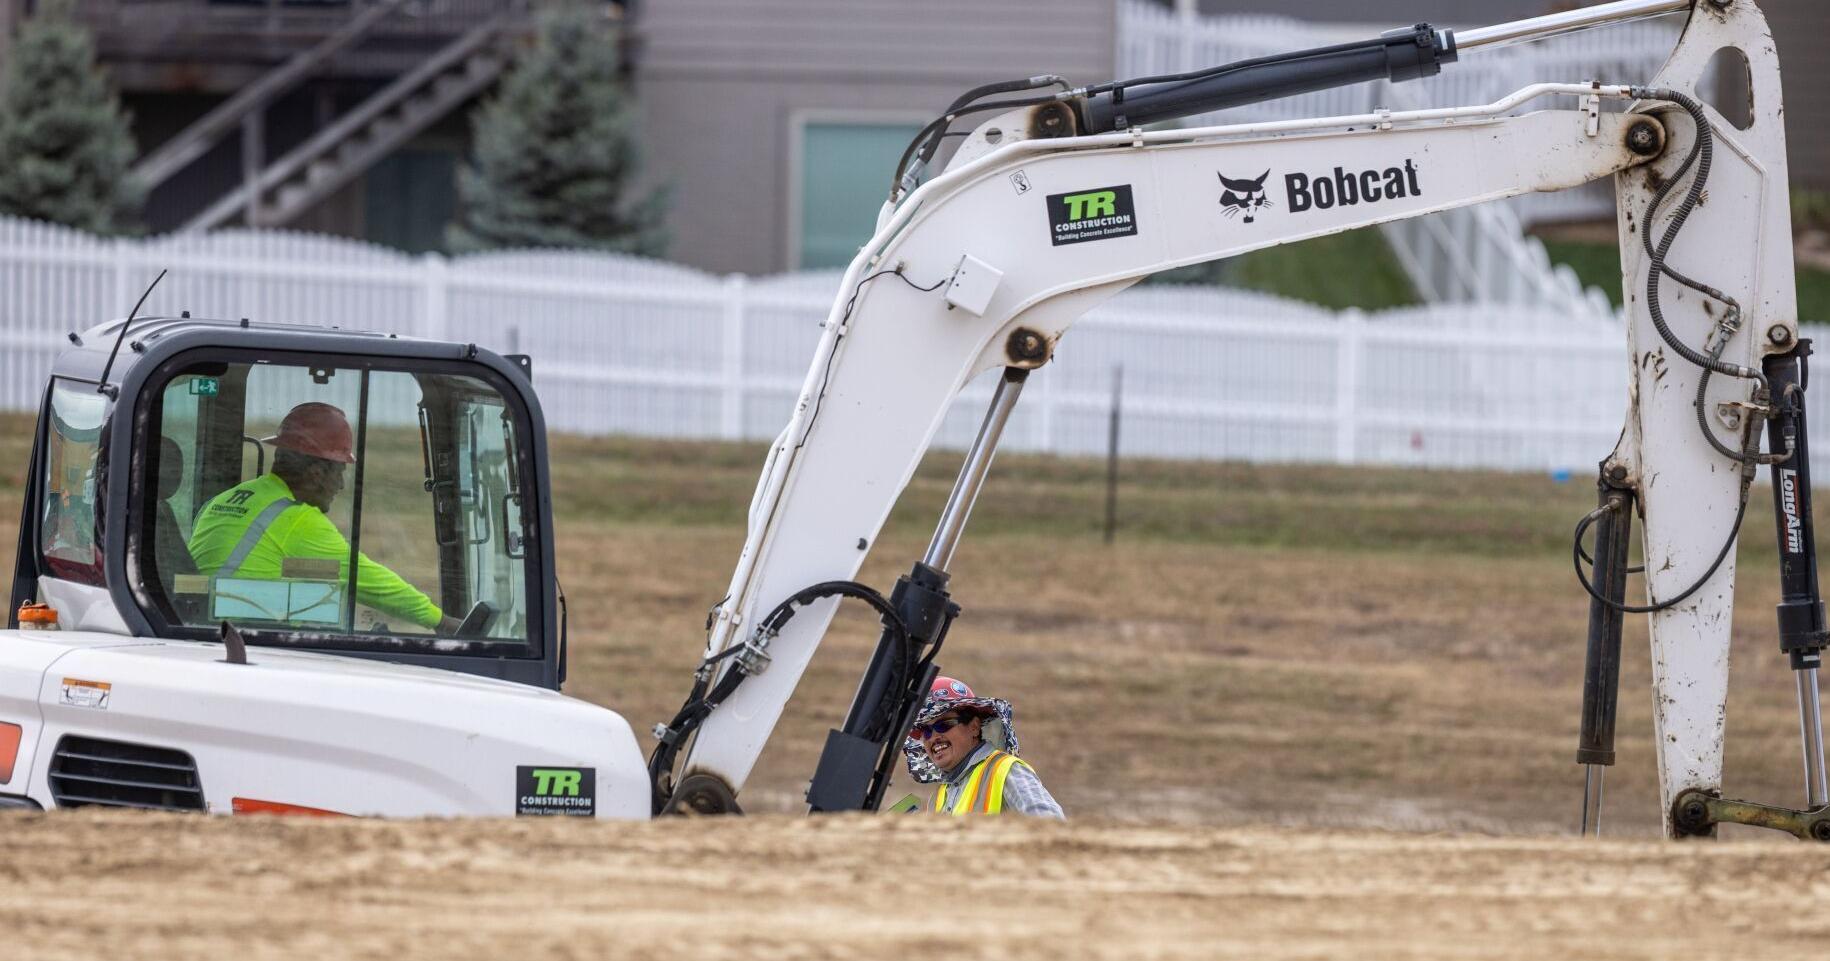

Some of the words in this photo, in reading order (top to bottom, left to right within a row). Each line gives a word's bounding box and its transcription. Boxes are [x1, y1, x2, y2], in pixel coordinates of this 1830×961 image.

[1284, 158, 1421, 213] Bobcat
[1063, 190, 1116, 221] TR
[1055, 214, 1131, 232] CONSTRUCTION
[1080, 229, 1103, 238] Concrete
[1780, 468, 1800, 553] LongArm
[532, 769, 582, 796] TR
[521, 796, 592, 806] CONSTRUCTION
